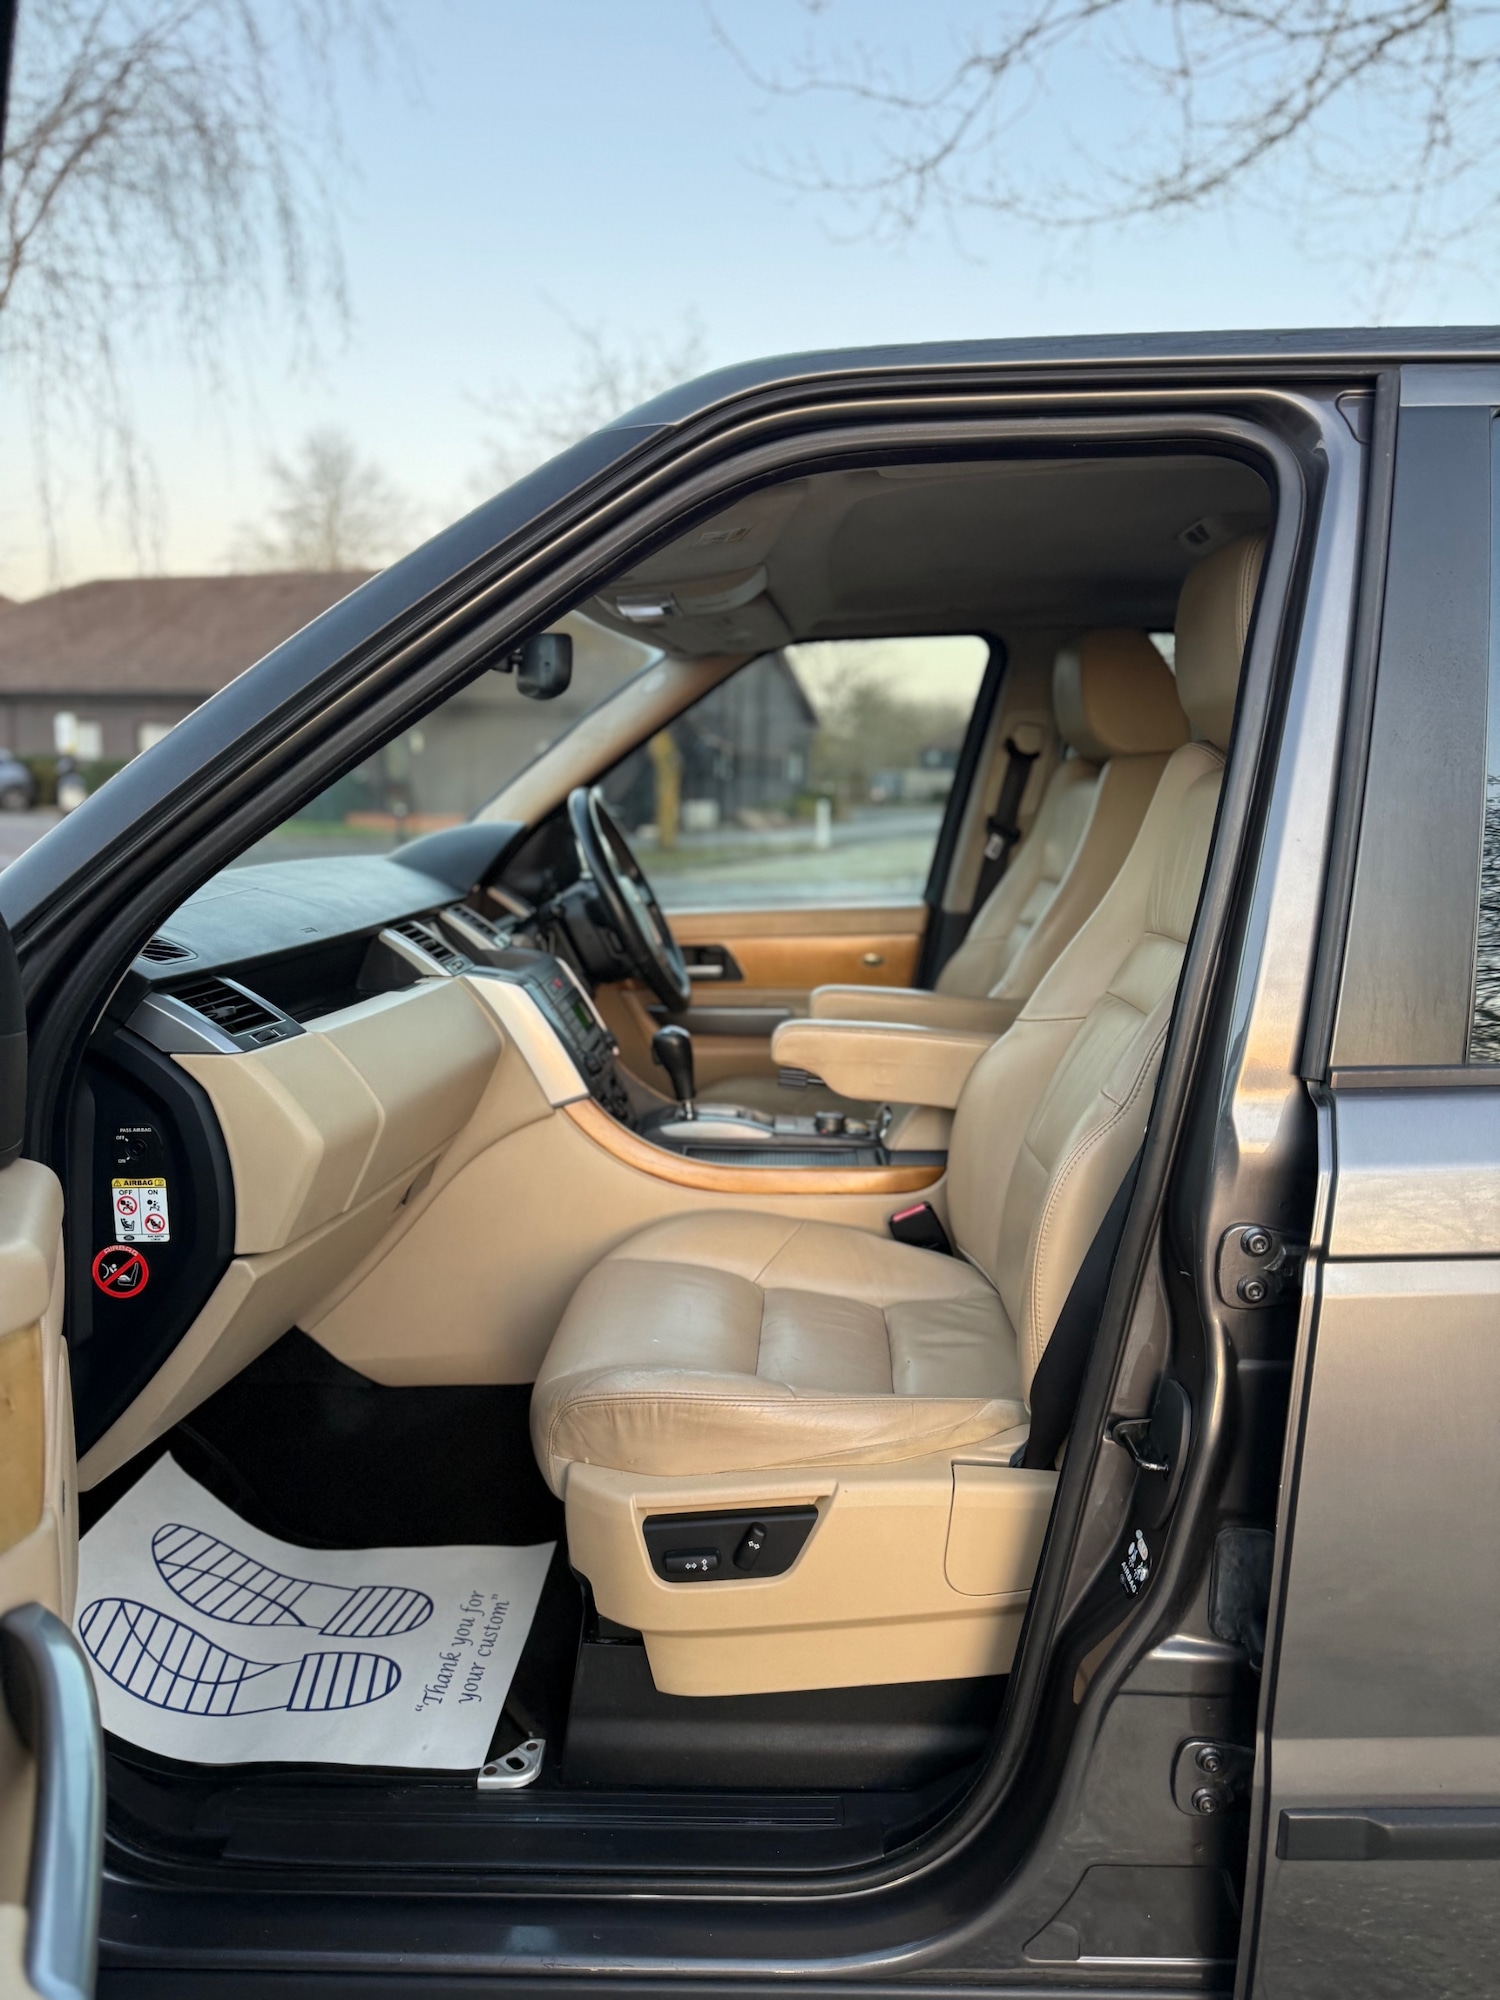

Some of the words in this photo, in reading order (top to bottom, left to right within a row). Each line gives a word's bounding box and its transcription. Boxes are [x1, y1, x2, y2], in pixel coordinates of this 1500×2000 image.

[123, 1179, 153, 1187] AIRBAG
[103, 1244, 139, 1257] AIRBAG
[460, 1590, 485, 1617] for
[451, 1617, 476, 1646] you
[458, 1662, 486, 1705] your
